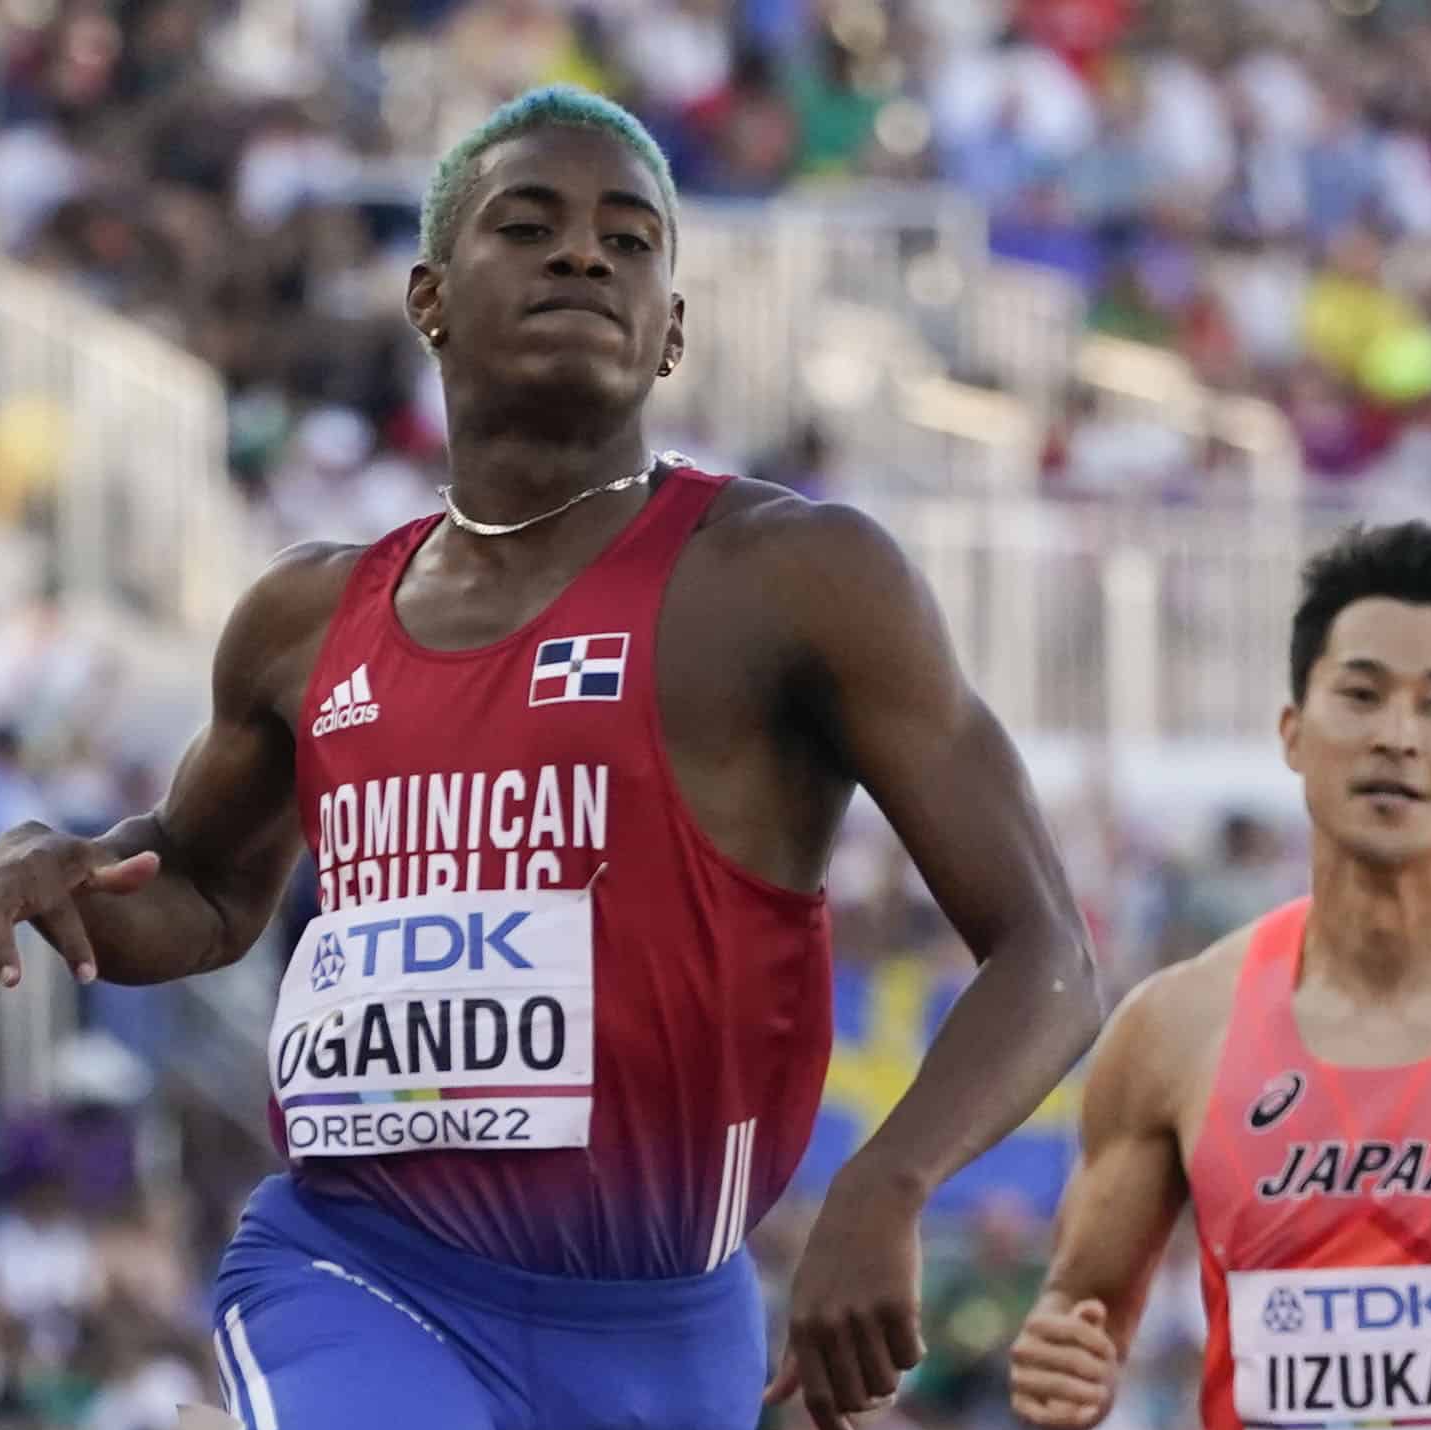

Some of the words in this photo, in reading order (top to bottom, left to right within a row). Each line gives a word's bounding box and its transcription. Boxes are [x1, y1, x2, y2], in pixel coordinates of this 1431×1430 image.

[312, 702, 380, 737] adidas
[318, 763, 609, 871] DOMINICAN
[347, 911, 535, 977] TDK
[276, 995, 566, 1090] OGANDO
[288, 1107, 532, 1149] OREGON22
